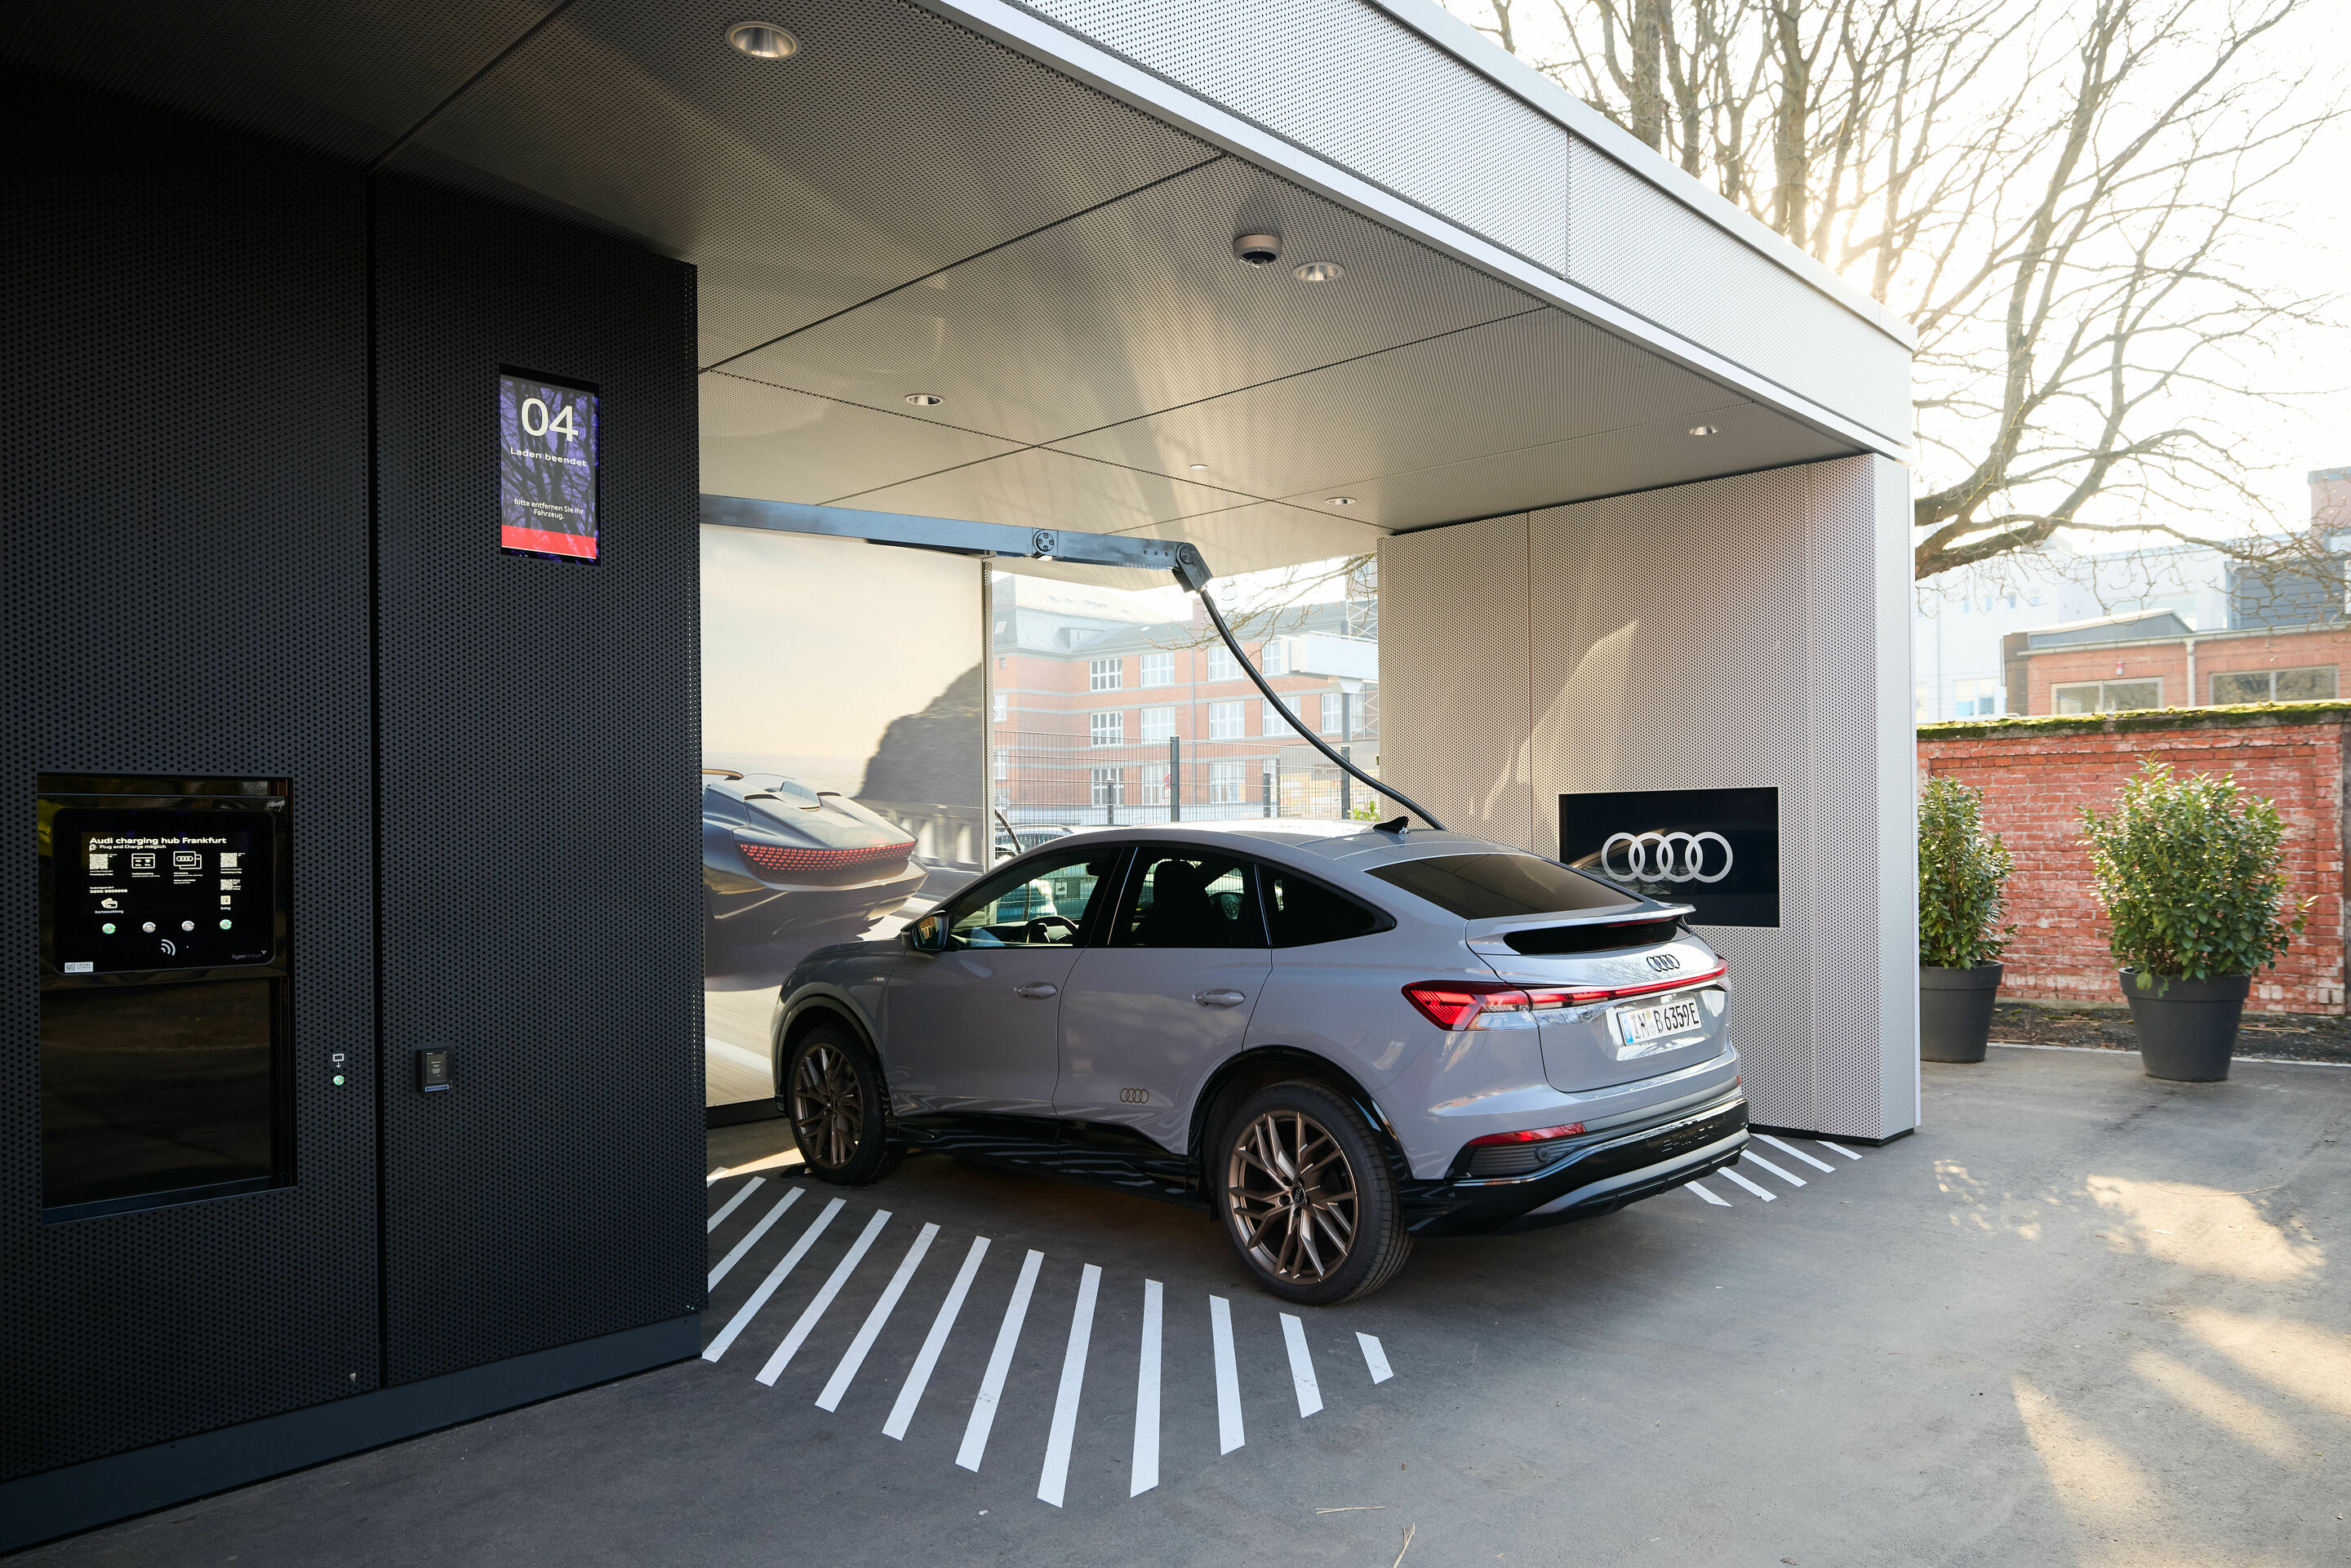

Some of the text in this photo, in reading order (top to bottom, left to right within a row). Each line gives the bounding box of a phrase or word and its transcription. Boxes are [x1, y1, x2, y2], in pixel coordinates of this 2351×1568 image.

[521, 398, 579, 442] 04
[510, 446, 587, 467] Laden beendet
[513, 498, 531, 507] Bitte
[531, 502, 563, 512] entfernen
[533, 509, 565, 521] Fahrzeug.
[115, 837, 159, 846] charging
